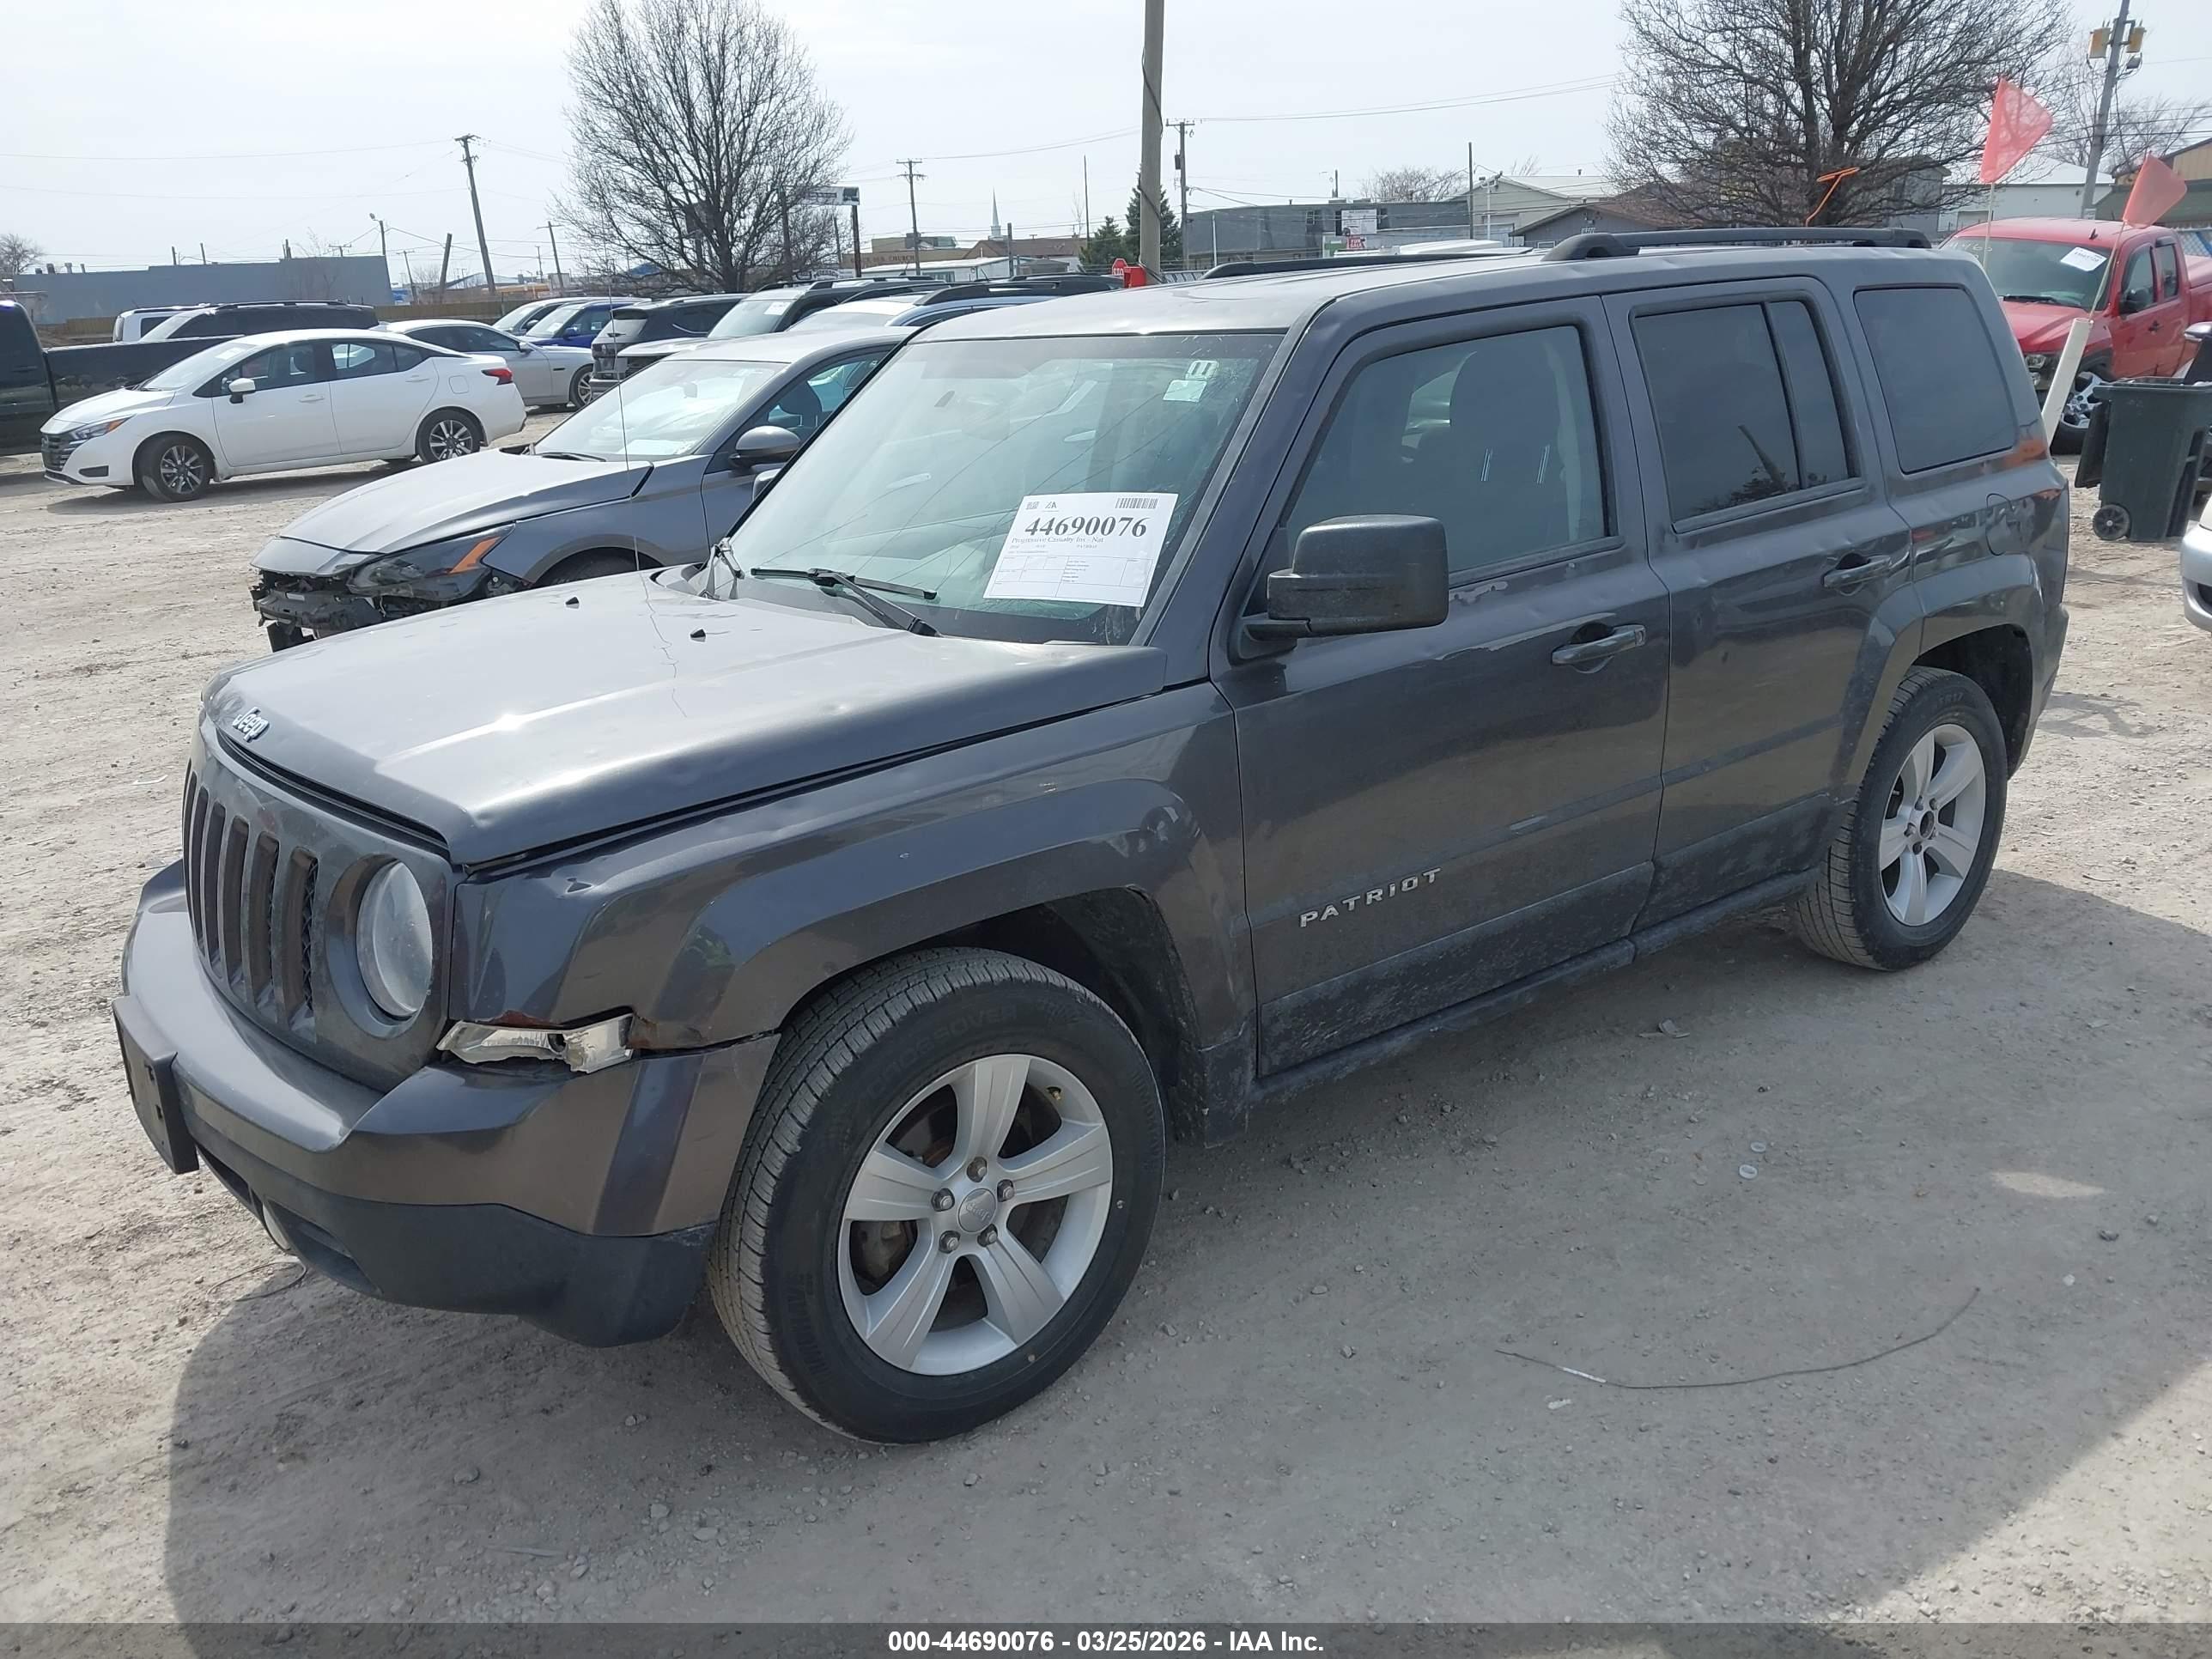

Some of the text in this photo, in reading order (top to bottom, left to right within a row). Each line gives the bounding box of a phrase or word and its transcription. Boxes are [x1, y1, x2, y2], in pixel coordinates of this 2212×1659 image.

[1113, 267, 1124, 276] STO
[1024, 516, 1153, 538] 44690076
[232, 706, 270, 741] Jeep
[1298, 866, 1442, 928] PATRIOT
